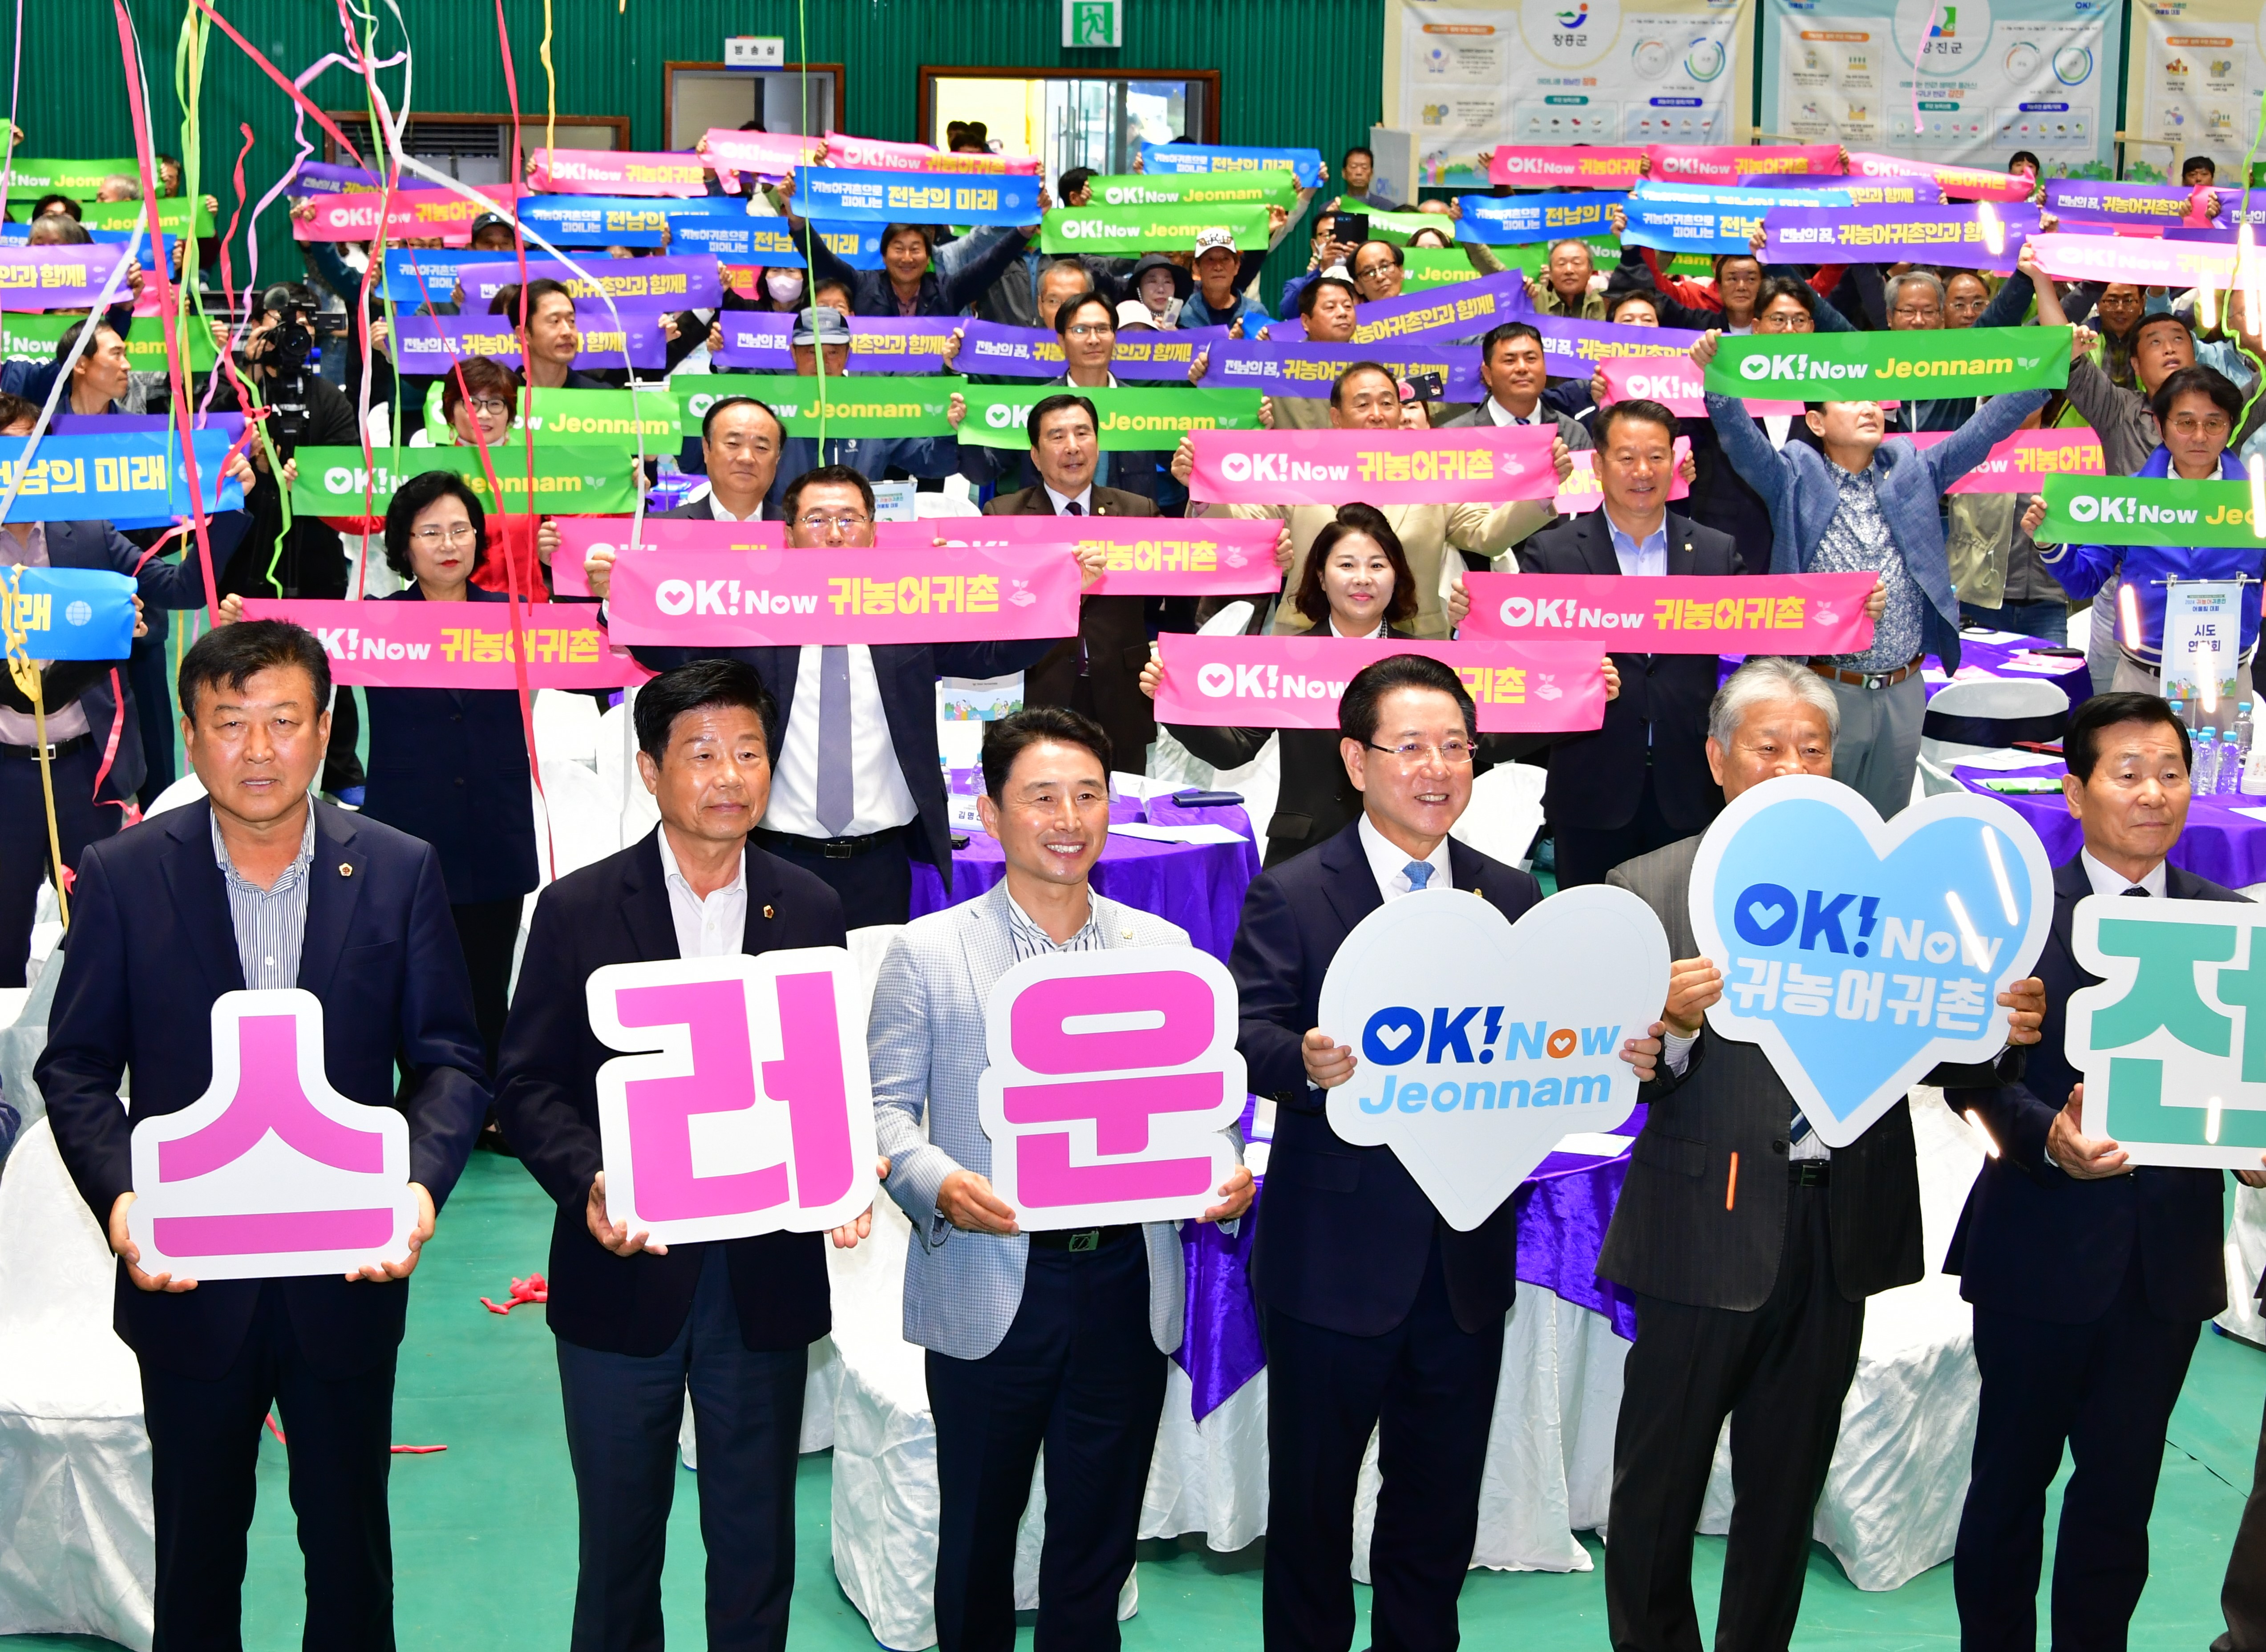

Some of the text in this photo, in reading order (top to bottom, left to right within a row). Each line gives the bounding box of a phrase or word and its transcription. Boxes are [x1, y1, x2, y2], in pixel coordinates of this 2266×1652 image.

[845, 146, 885, 166] OK!
[886, 155, 920, 170] Now
[1507, 157, 1543, 174] OK!
[1544, 163, 1574, 174] Now
[1663, 157, 1809, 174] OK! Now 귀농어귀촌
[18, 174, 50, 187] Now
[54, 174, 105, 187] Jeonn
[551, 162, 704, 184] OK! Now 귀농어귀촌
[1862, 160, 1899, 177] OK!
[1933, 168, 2006, 190] 귀농어귀촌
[811, 180, 882, 196] 귀농어귀촌으로
[888, 185, 998, 211] 전남의 미래
[1105, 187, 1262, 205] OK! Now Jeonnam
[1885, 187, 1914, 203] 함께!
[841, 195, 882, 208] 피어나는
[2057, 194, 2087, 208] 전남의
[2102, 195, 2181, 216] 귀농어귀촌인
[329, 207, 372, 227] OK!
[532, 209, 601, 222] 귀농어귀촌으로
[606, 211, 666, 232] 전남의
[1502, 219, 1541, 231] 피어나는
[1545, 204, 1600, 227] 전남의
[1642, 212, 1714, 227] 귀농어귀촌으로
[562, 222, 601, 233] 피어나는
[680, 229, 749, 242] 귀농어귀촌으로
[1061, 220, 1231, 239] OK! Now Jeonn
[1672, 227, 1714, 239] 피어나는
[1720, 216, 1765, 238] 전남
[1780, 227, 1817, 243] 전남의
[1818, 227, 1835, 244] 꿈,
[1837, 222, 1962, 245] 귀농어귀촌인과
[708, 241, 749, 253] 피어나는
[754, 231, 797, 253] 전남
[1592, 246, 1623, 257] Now
[40, 264, 87, 288] 함께!
[400, 263, 457, 276] 귀농어귀촌으
[1418, 267, 1482, 281] Jeonn
[429, 276, 454, 288] 피어
[650, 274, 687, 294] 함께!
[1455, 293, 1495, 321] 함께!
[403, 336, 442, 353] 전남의
[736, 332, 773, 348] 전남의
[773, 333, 790, 351] 꿈,
[909, 335, 946, 355] 함께!
[975, 340, 1013, 357] 전남의
[1014, 343, 1030, 360] 꿈,
[1153, 343, 1193, 362] 함께!
[1557, 338, 1574, 357] 꿈,
[1224, 359, 1263, 376] 전남의
[1264, 360, 1280, 379] 꿈,
[1740, 354, 2013, 381] OK! Now Jeonnam
[1626, 375, 1680, 399] OK!
[773, 399, 921, 419] ow Jeonnam
[985, 403, 1216, 431] OK Jeonnam
[549, 413, 669, 435] Jeonnam
[1221, 450, 1494, 482] OK! Now 귀농어귀촌
[2014, 445, 2105, 474] 귀농어귀
[94, 455, 166, 493] 미래
[324, 467, 387, 495] OK!
[2069, 495, 2137, 524] OK!
[2139, 505, 2198, 524] Now
[656, 574, 1000, 616] OK! Now 귀농어귀촌
[1500, 596, 1805, 630] OK! Now 귀농어귀촌
[2194, 624, 2216, 637] 시도
[304, 628, 600, 664] K! Now 귀농어귀촌
[1197, 663, 1279, 699] OK!
[1283, 674, 1350, 699] Now
[1734, 882, 2003, 969] OK! Now
[1731, 956, 1988, 1032] 귀농어귀촌
[1361, 1005, 1621, 1065] OK! Now
[2089, 918, 2266, 1149] 전
[615, 971, 854, 1223] 러
[1003, 970, 1225, 1209] 운
[1359, 1073, 1611, 1115] Jeonnam
[154, 1014, 394, 1258] 스
